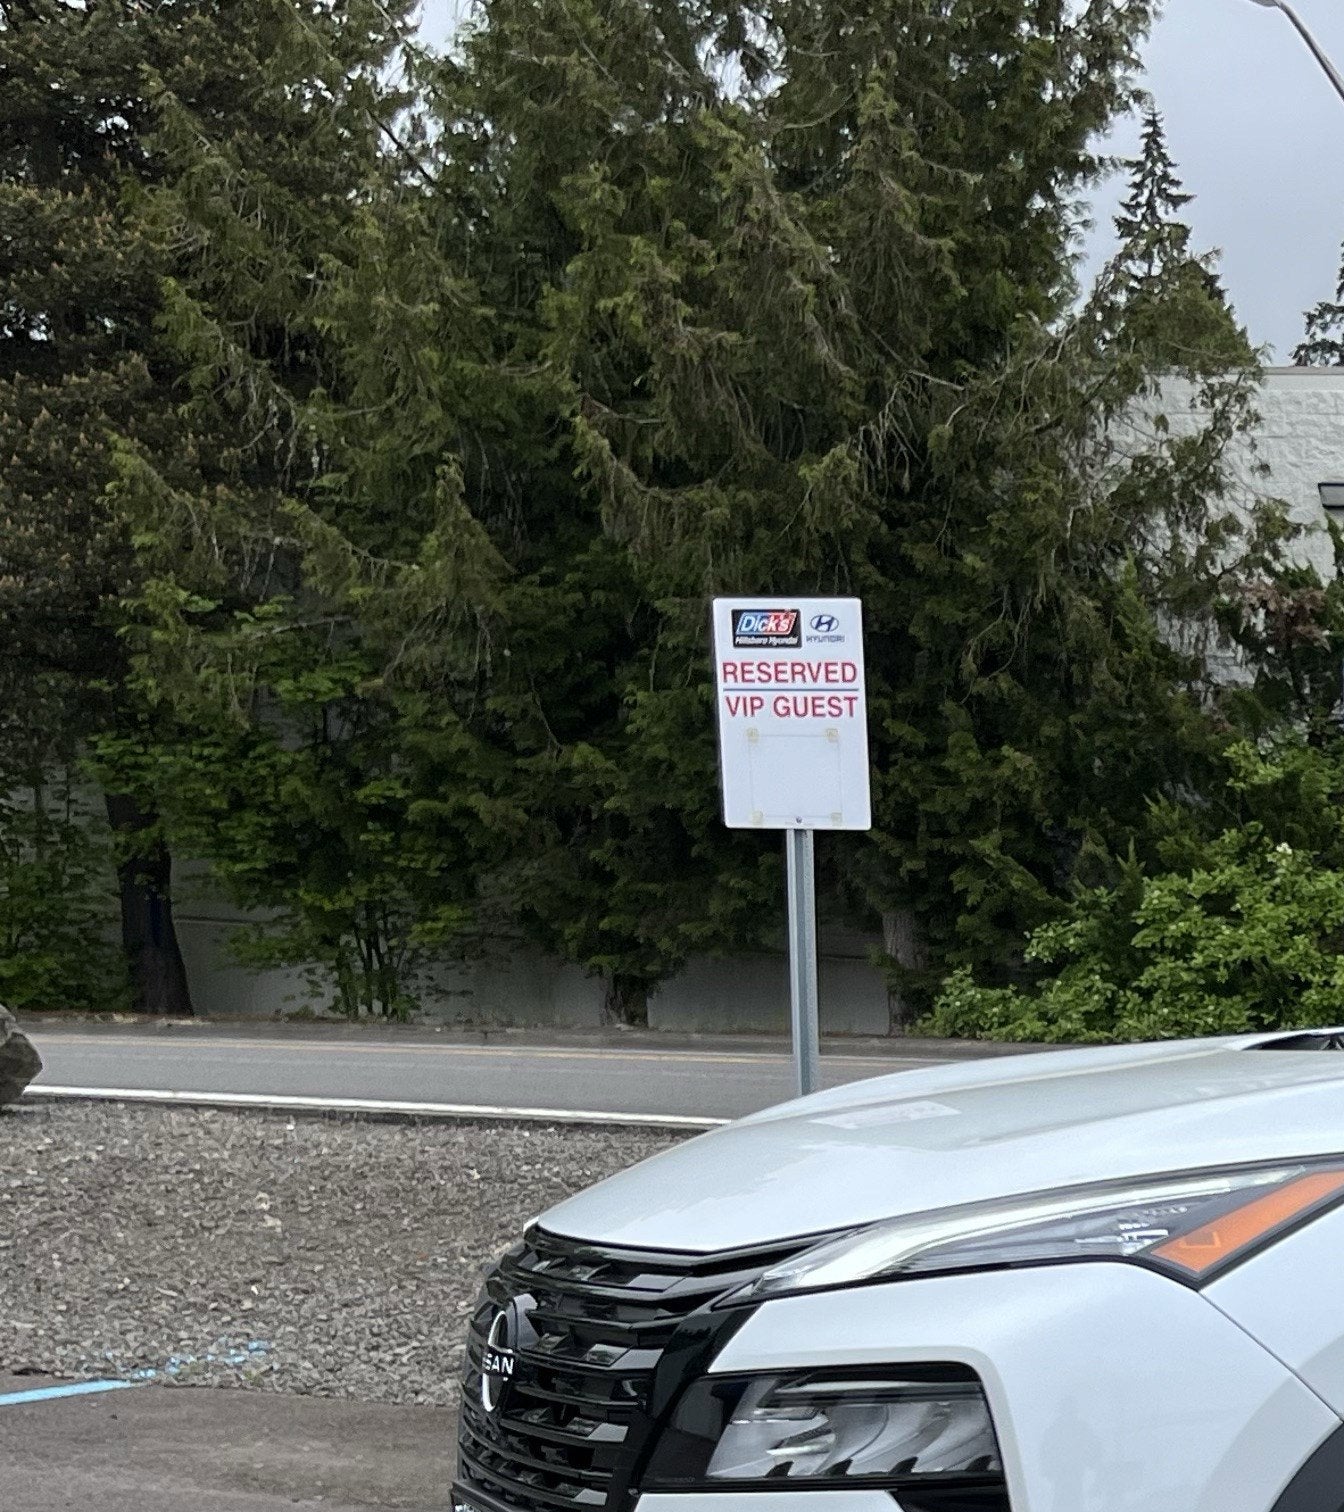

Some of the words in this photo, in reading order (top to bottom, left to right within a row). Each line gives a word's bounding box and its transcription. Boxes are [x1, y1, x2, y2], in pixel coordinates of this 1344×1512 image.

[722, 661, 859, 684] RESERVED
[725, 696, 765, 719] VIP
[773, 696, 860, 719] GUEST
